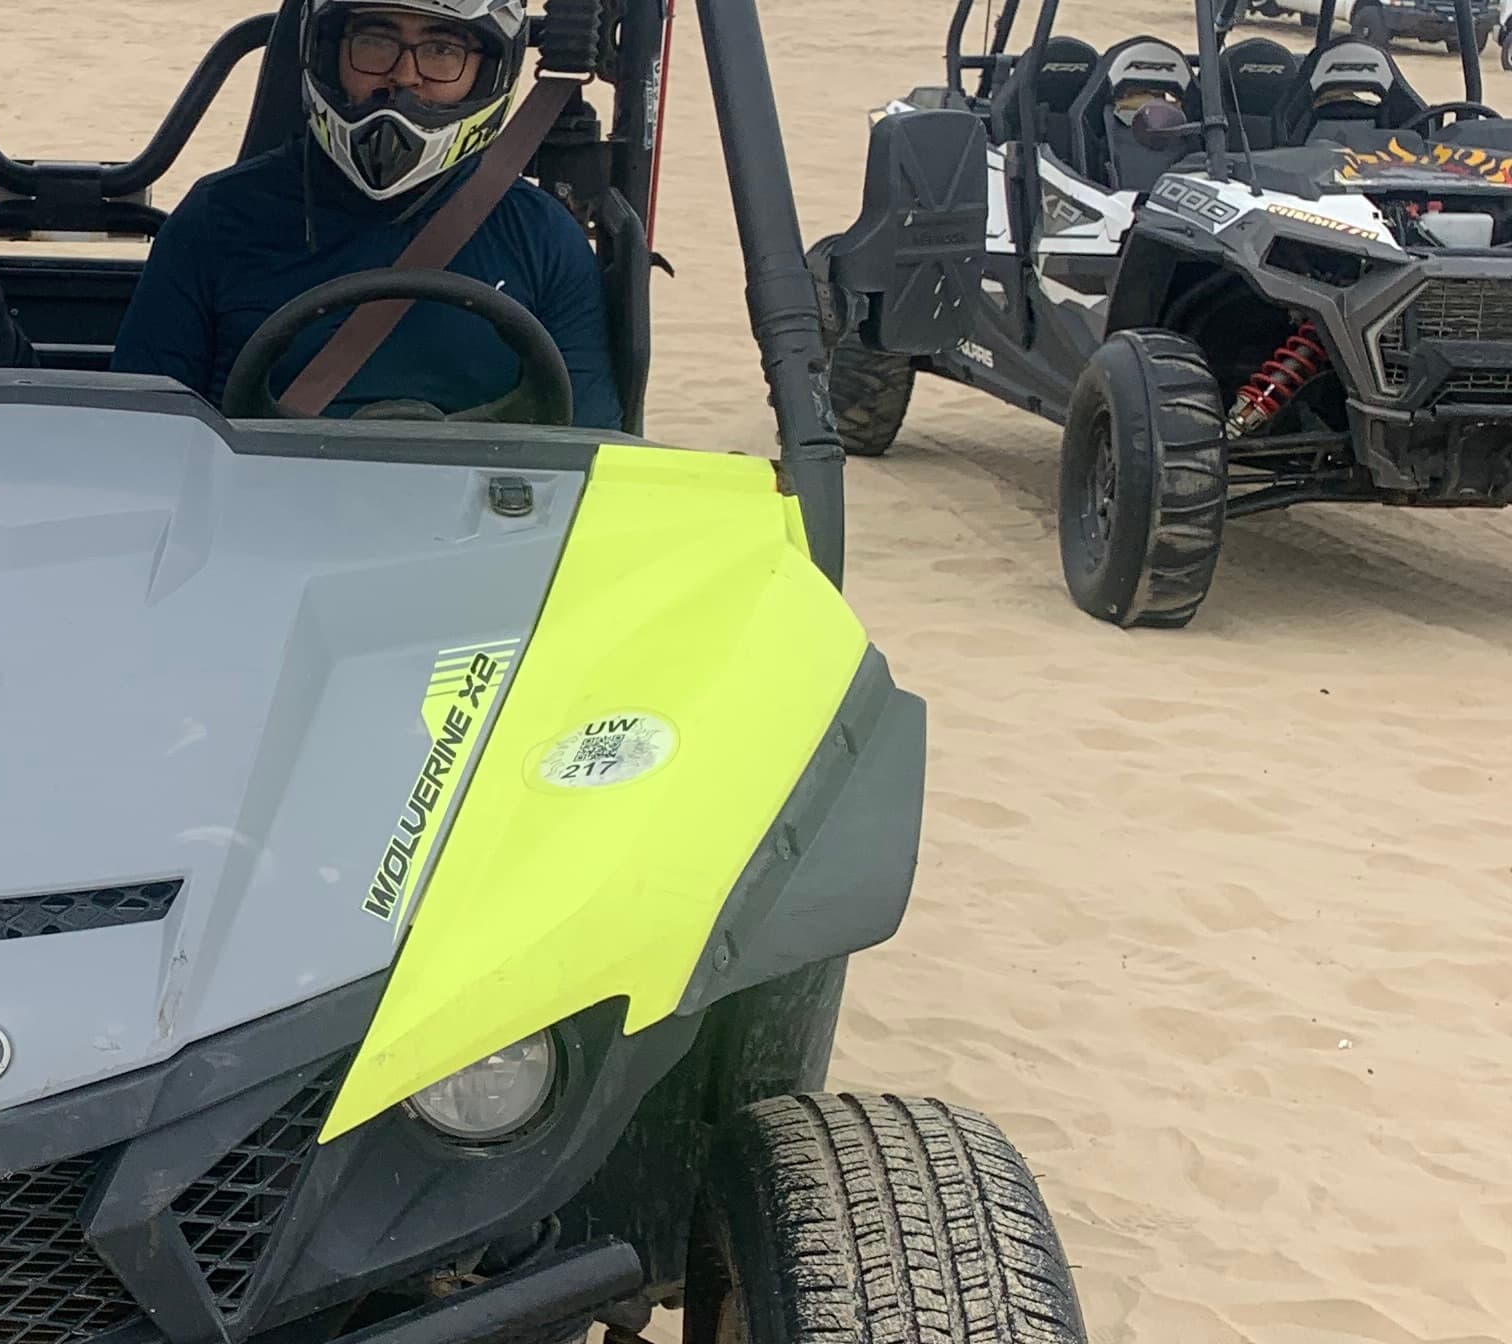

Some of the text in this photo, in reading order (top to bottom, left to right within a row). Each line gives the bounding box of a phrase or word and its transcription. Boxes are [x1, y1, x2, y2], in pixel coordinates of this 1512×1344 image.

[1155, 179, 1240, 224] 1000
[584, 717, 639, 736] UW
[363, 652, 498, 920] WOLVERINE X2
[560, 760, 618, 780] 217
